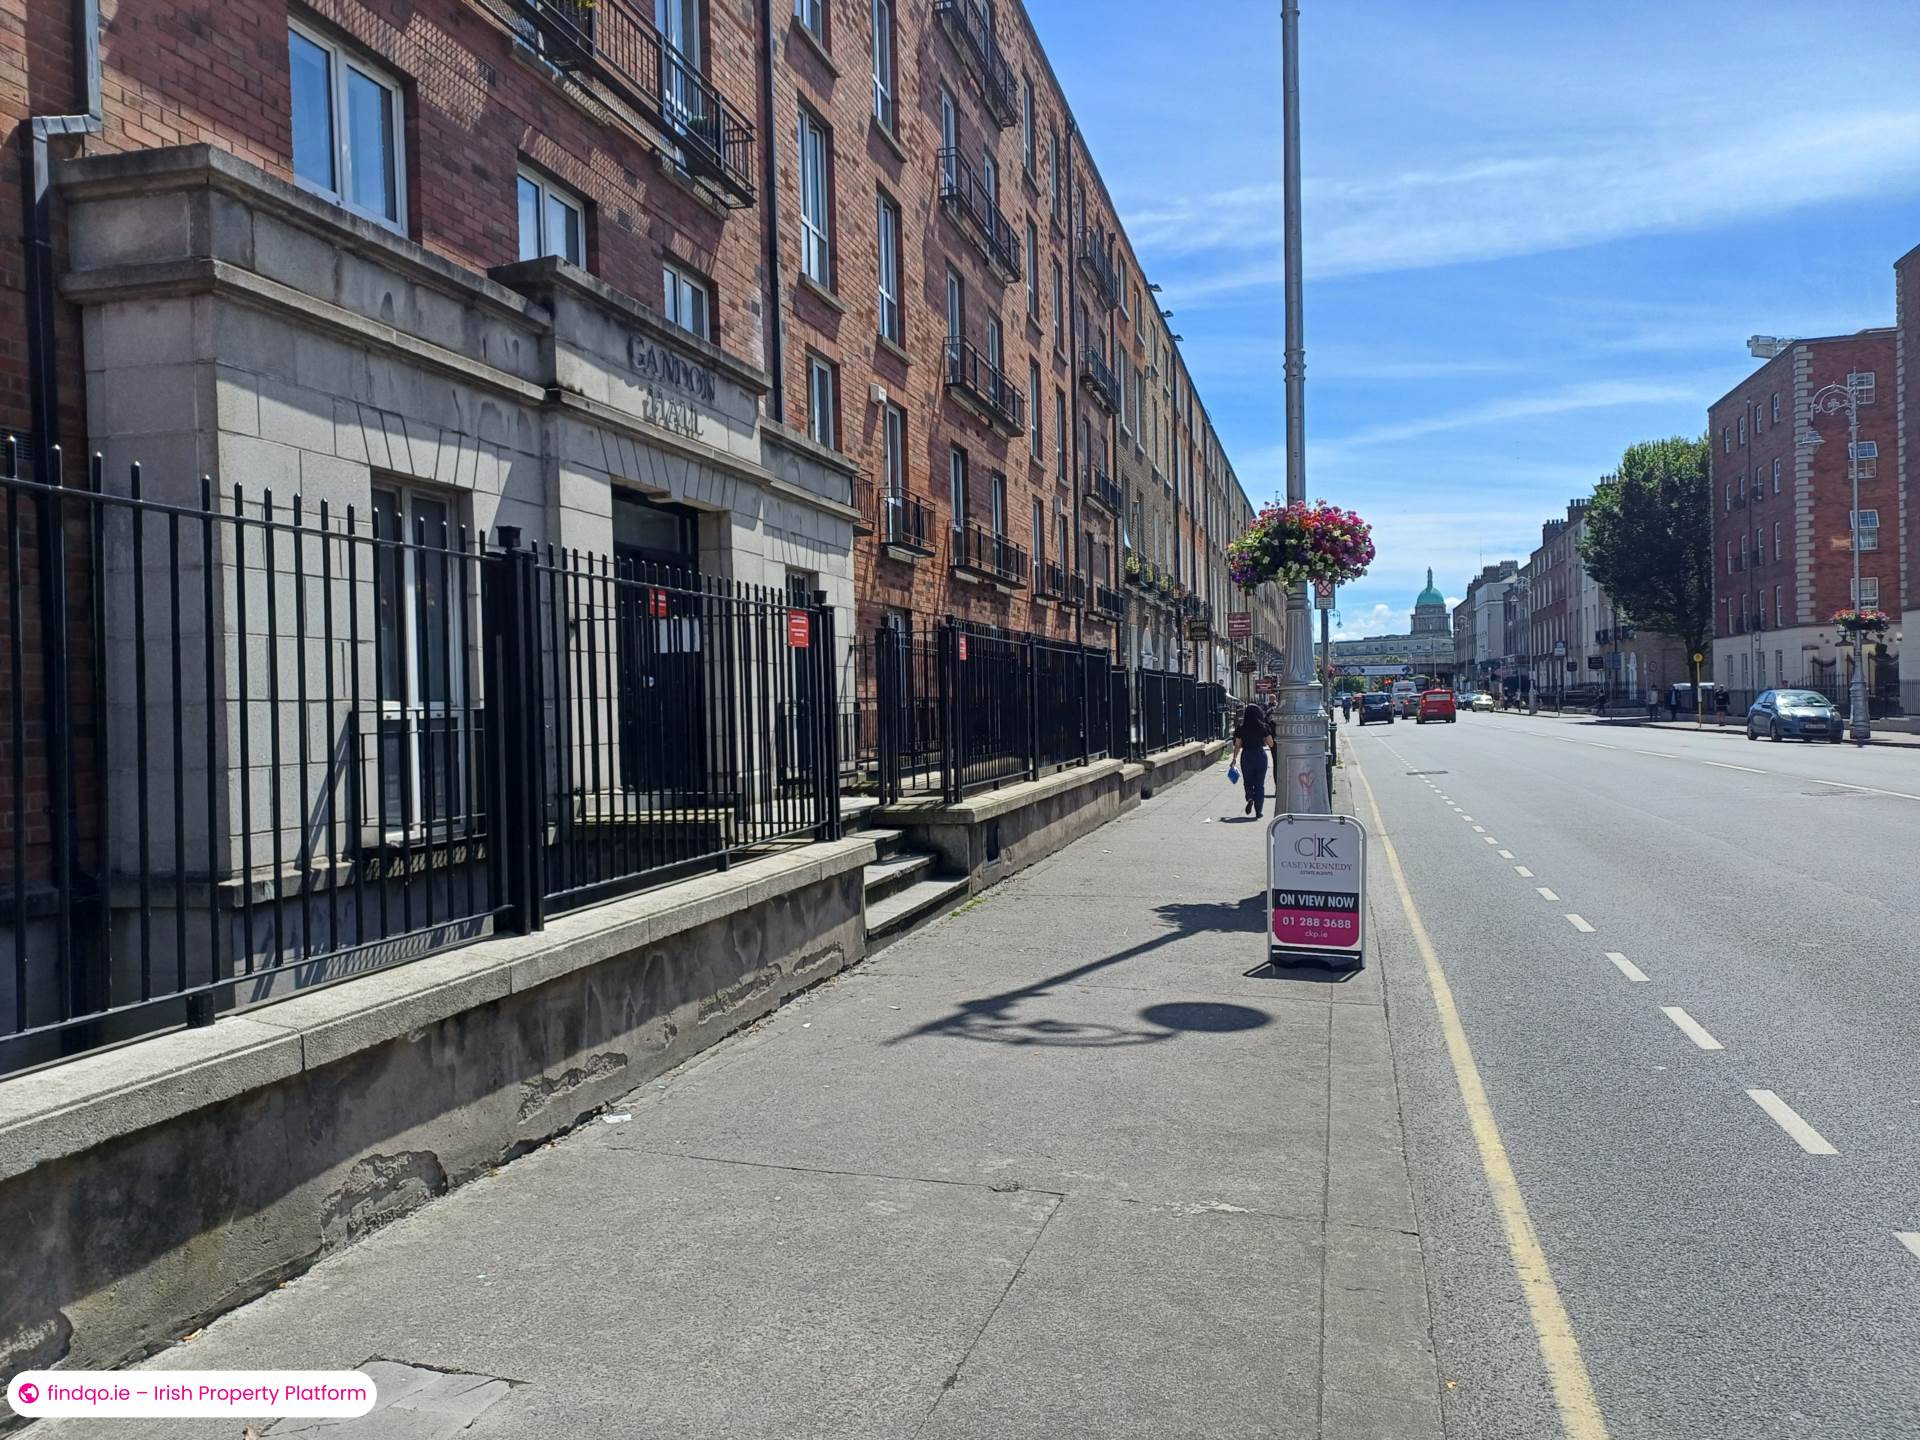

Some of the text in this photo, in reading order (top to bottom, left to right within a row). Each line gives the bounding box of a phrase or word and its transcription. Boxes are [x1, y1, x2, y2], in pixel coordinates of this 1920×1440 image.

[627, 333, 716, 402] GANDON
[647, 384, 704, 438] HALL
[1280, 894, 1355, 908] ON VIEW NOW
[1282, 916, 1352, 929] 01 288 3688
[1305, 930, 1328, 938] ckp.ie
